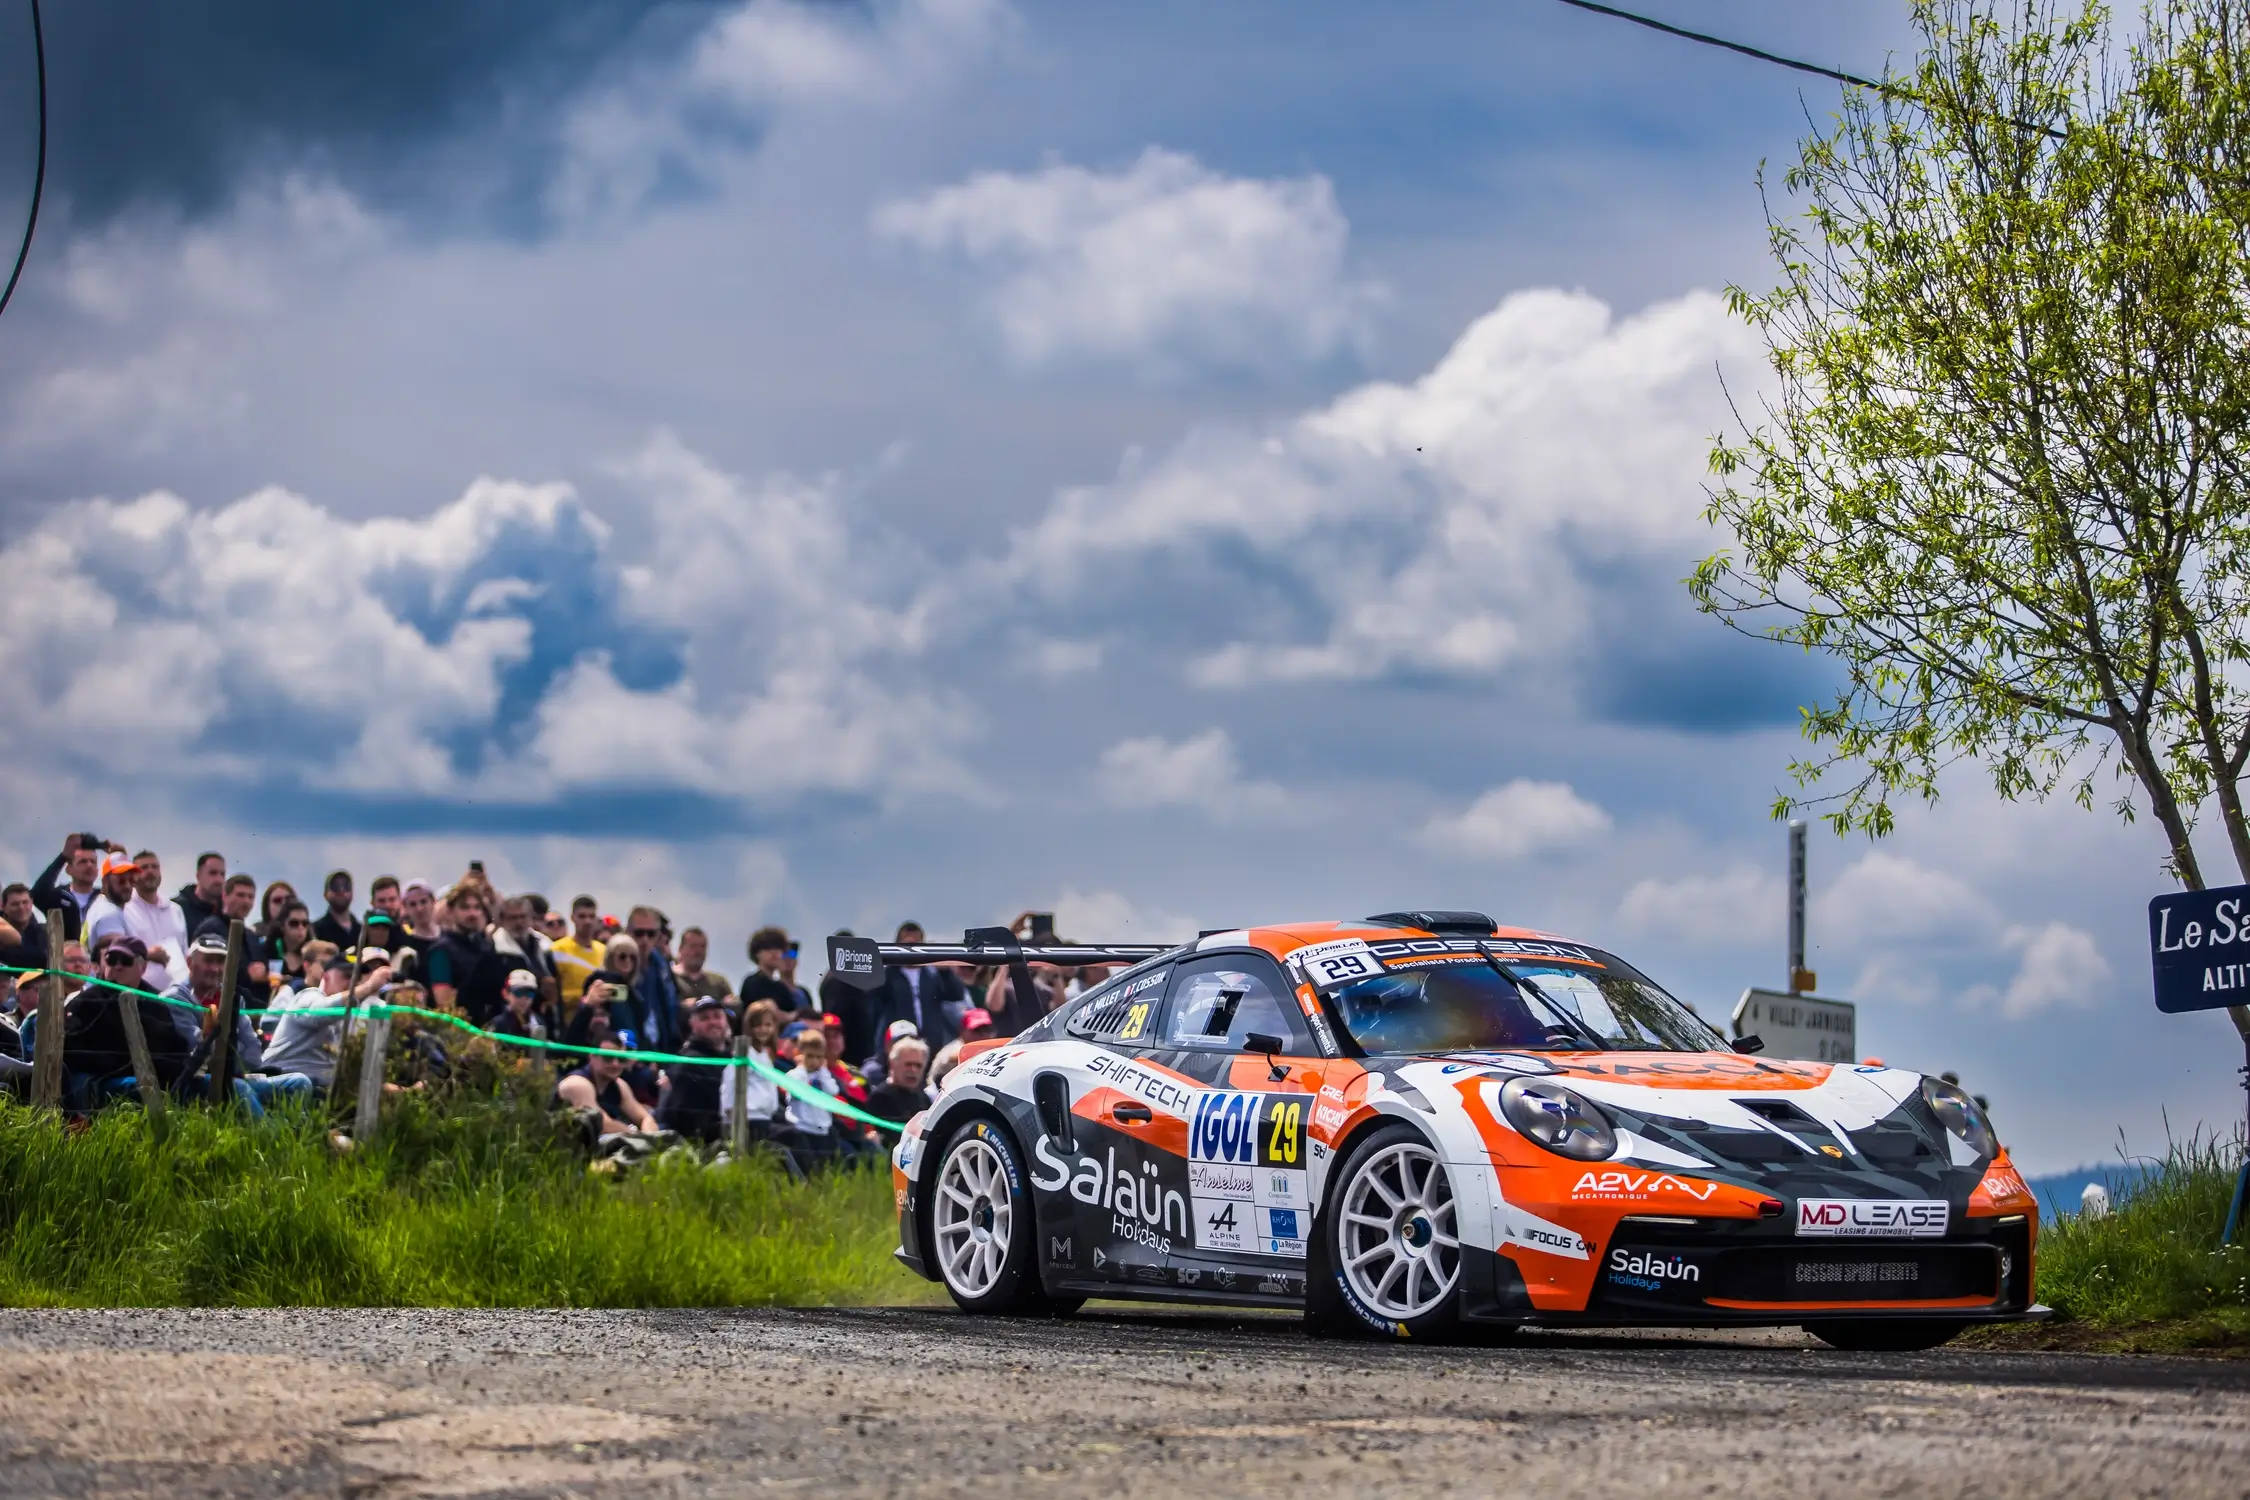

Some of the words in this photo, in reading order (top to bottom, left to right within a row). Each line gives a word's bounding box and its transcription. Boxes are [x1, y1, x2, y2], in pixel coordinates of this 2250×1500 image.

[2160, 907, 2202, 952] Le
[845, 949, 873, 963] Brionne
[1369, 940, 1592, 960] COSSON
[853, 962, 873, 971] Industrie
[1320, 956, 1368, 980] 29
[1094, 990, 1121, 1012] MILLET
[1121, 1003, 1149, 1039] 29
[1086, 1056, 1191, 1113] SHIFTECH
[1190, 1093, 1259, 1162] IGOL
[1269, 1102, 1301, 1163] 29
[989, 1133, 1019, 1189] MICHELIN
[1030, 1133, 1186, 1238] Salaün
[1191, 1165, 1252, 1192] Anselme
[1572, 1172, 1648, 1192] A2V
[1272, 1212, 1295, 1226] RHÔNE
[1802, 1204, 1846, 1226] MD
[1852, 1205, 1946, 1226] LEASE
[1112, 1214, 1171, 1254] Holidays
[1209, 1232, 1241, 1241] ALPINE
[1532, 1229, 1572, 1248] FOCUS
[1576, 1240, 1597, 1254] ON
[1834, 1227, 1867, 1235] LEASING
[1868, 1228, 1915, 1236] AUTOMOBILE
[1279, 1240, 1285, 1248] La
[1285, 1240, 1303, 1250] Région
[1610, 1248, 1700, 1282] Salaün
[1844, 1262, 1879, 1281] SPORT
[1879, 1262, 1920, 1281] EVENTS
[1608, 1272, 1661, 1291] Holidays
[1337, 1276, 1386, 1331] MICHELIN
